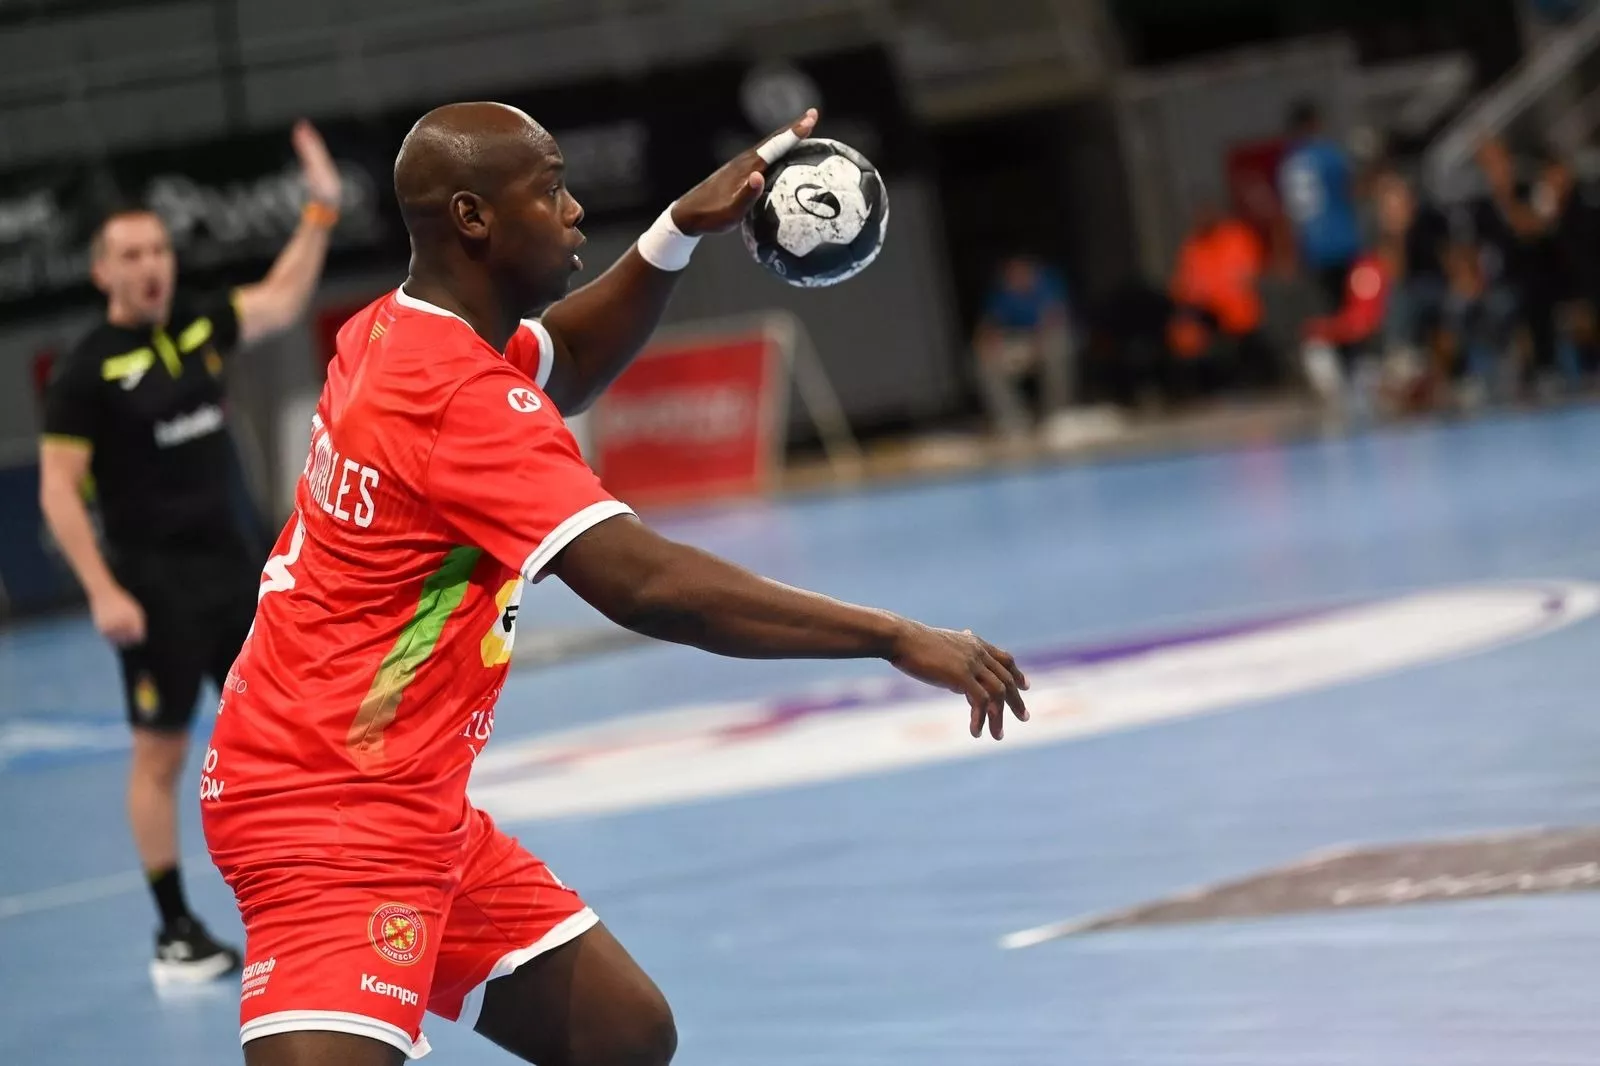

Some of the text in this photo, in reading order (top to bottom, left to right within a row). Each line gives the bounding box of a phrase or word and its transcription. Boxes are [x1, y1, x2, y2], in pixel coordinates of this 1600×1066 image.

[379, 906, 422, 930] BALONMANO
[381, 945, 414, 961] HUESCA
[360, 973, 419, 1006] Kempa
